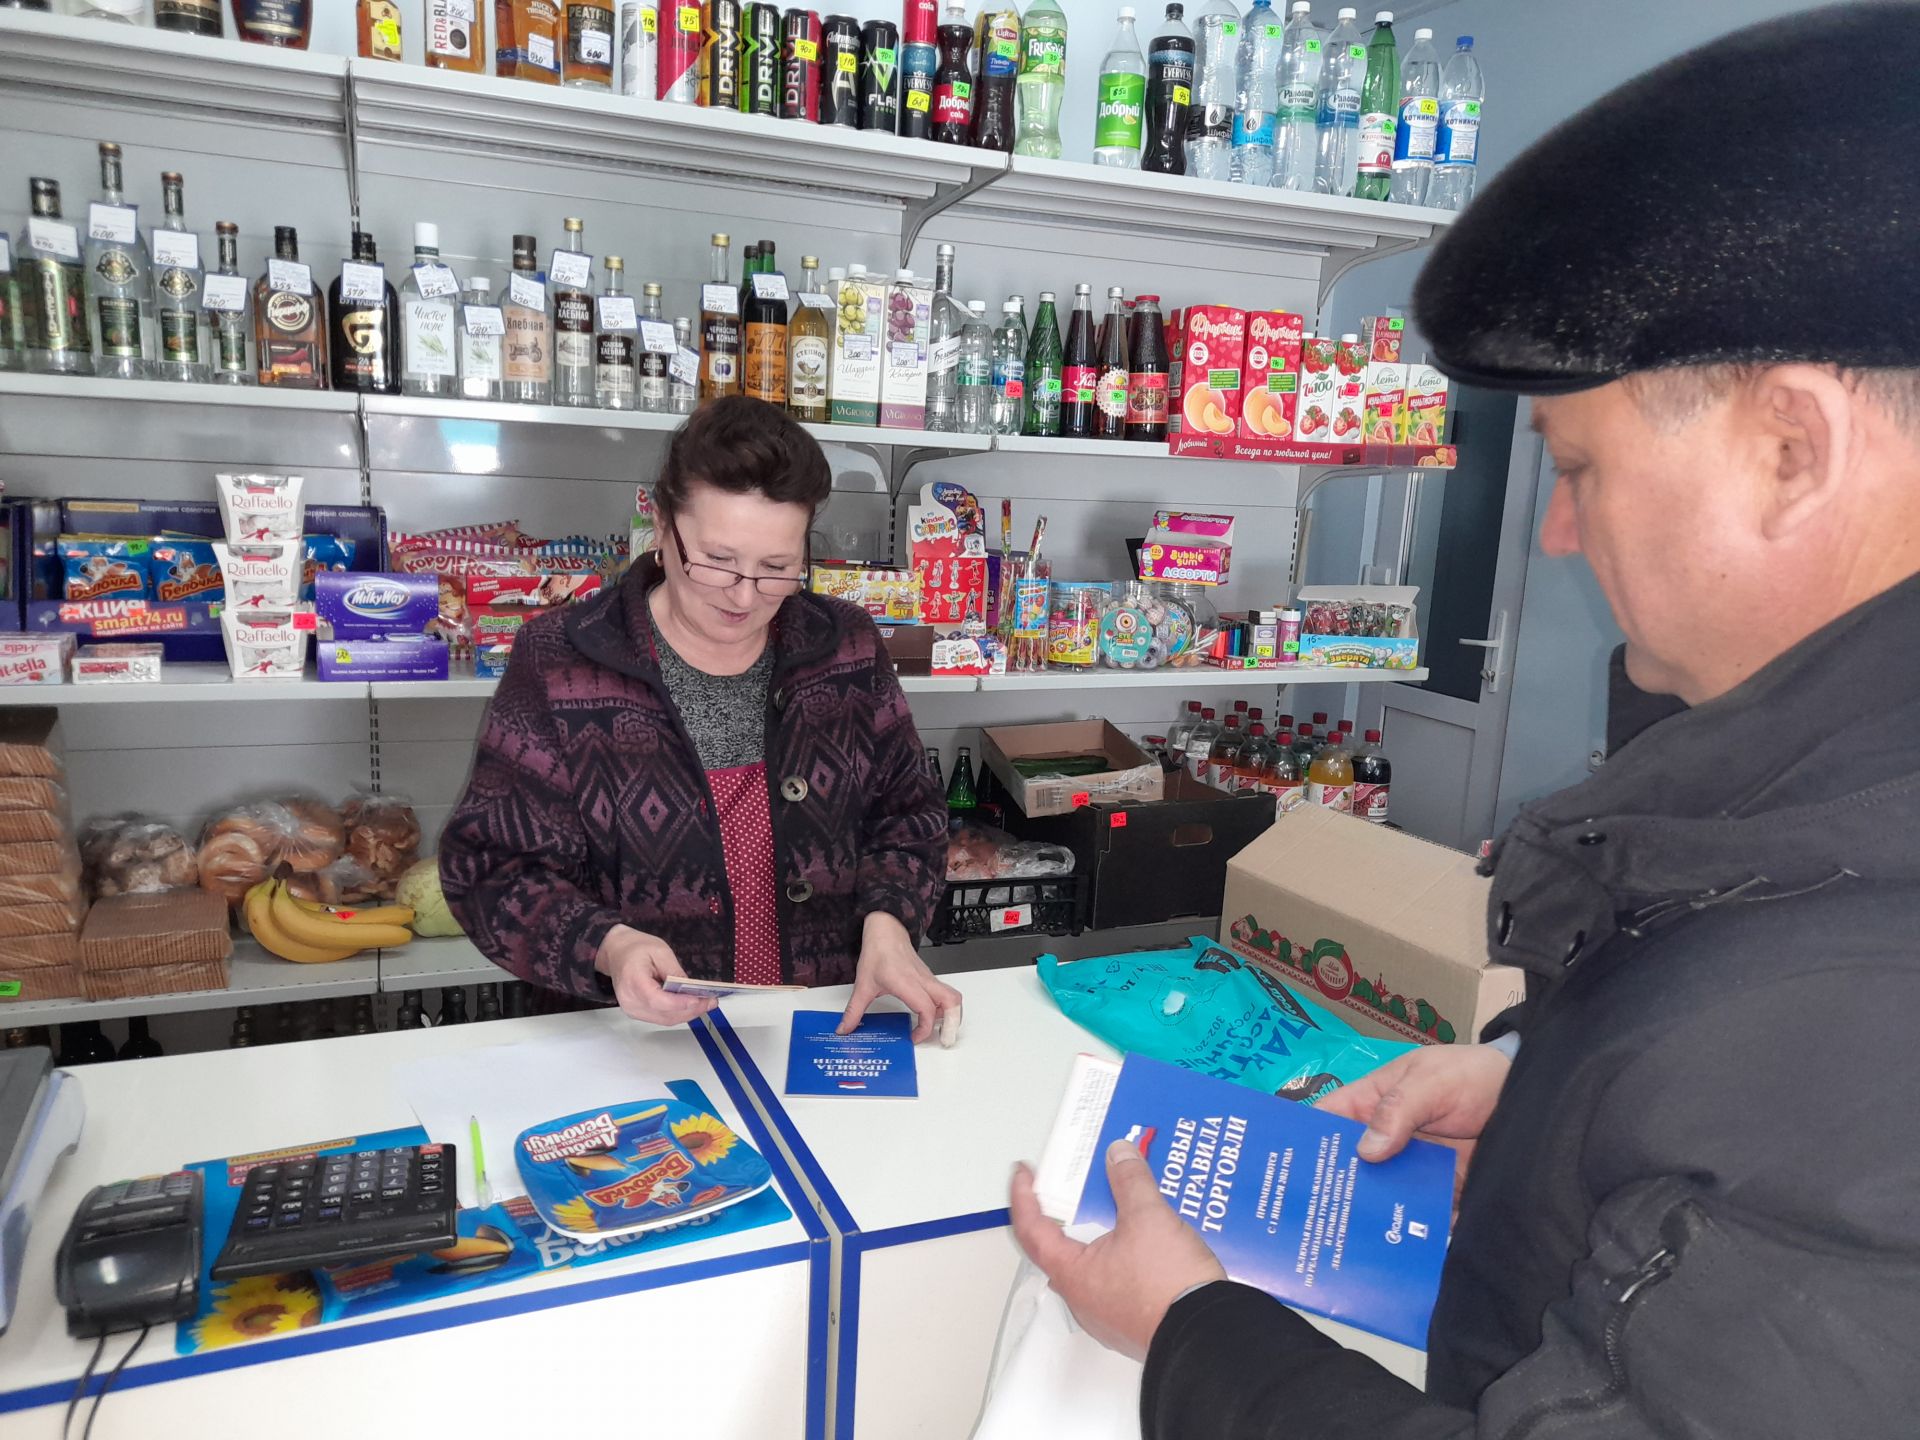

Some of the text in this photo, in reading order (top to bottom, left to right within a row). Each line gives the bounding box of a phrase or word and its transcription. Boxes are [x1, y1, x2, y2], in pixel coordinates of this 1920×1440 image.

[1099, 101, 1140, 119] Добрый
[1235, 445, 1332, 461] Всегда по любимой цене!
[231, 494, 293, 509] Raffaello
[921, 515, 945, 525] Kinder
[1170, 549, 1204, 562] Bubble
[1176, 558, 1198, 567] gum
[227, 562, 288, 577] Raffaello
[1162, 567, 1217, 581] АССОРТИ
[95, 612, 183, 631] smart74.ru
[235, 628, 296, 643] Raffaello
[1258, 660, 1277, 668] Cricket
[813, 1058, 892, 1066] ТОРГОВЛИ
[525, 1114, 615, 1148] Белочку!
[532, 1129, 618, 1163] Любишь
[1159, 1117, 1197, 1198] НОВЫЕ
[1284, 1148, 1294, 1168] ГОДА
[1179, 1117, 1223, 1219] ПРАВИЛА
[1201, 1115, 1248, 1232] ТОРГОВЛИ
[1278, 1166, 1289, 1185] 2021
[1256, 1151, 1278, 1219] ПРИМЕНЯЮТСЯ
[1332, 1169, 1345, 1202] ОТПУСКА
[1270, 1184, 1286, 1220] ЯНВАРЯ
[1295, 1136, 1329, 1274] ВКЛЮЧАЯ ПРАВИЛА ОКАЗАНИЯ УСЛУГ
[1304, 1133, 1341, 1287] ПО РЕАЛИЗАЦИИ ТУРИСТСКОГО ПРОДУКТА
[1326, 1202, 1340, 1238] ПРАВИЛА
[1331, 1157, 1358, 1271] ЛЕКАРСТВЕННЫХ ПРЕПАРАТОВ
[1267, 1226, 1277, 1234] С
